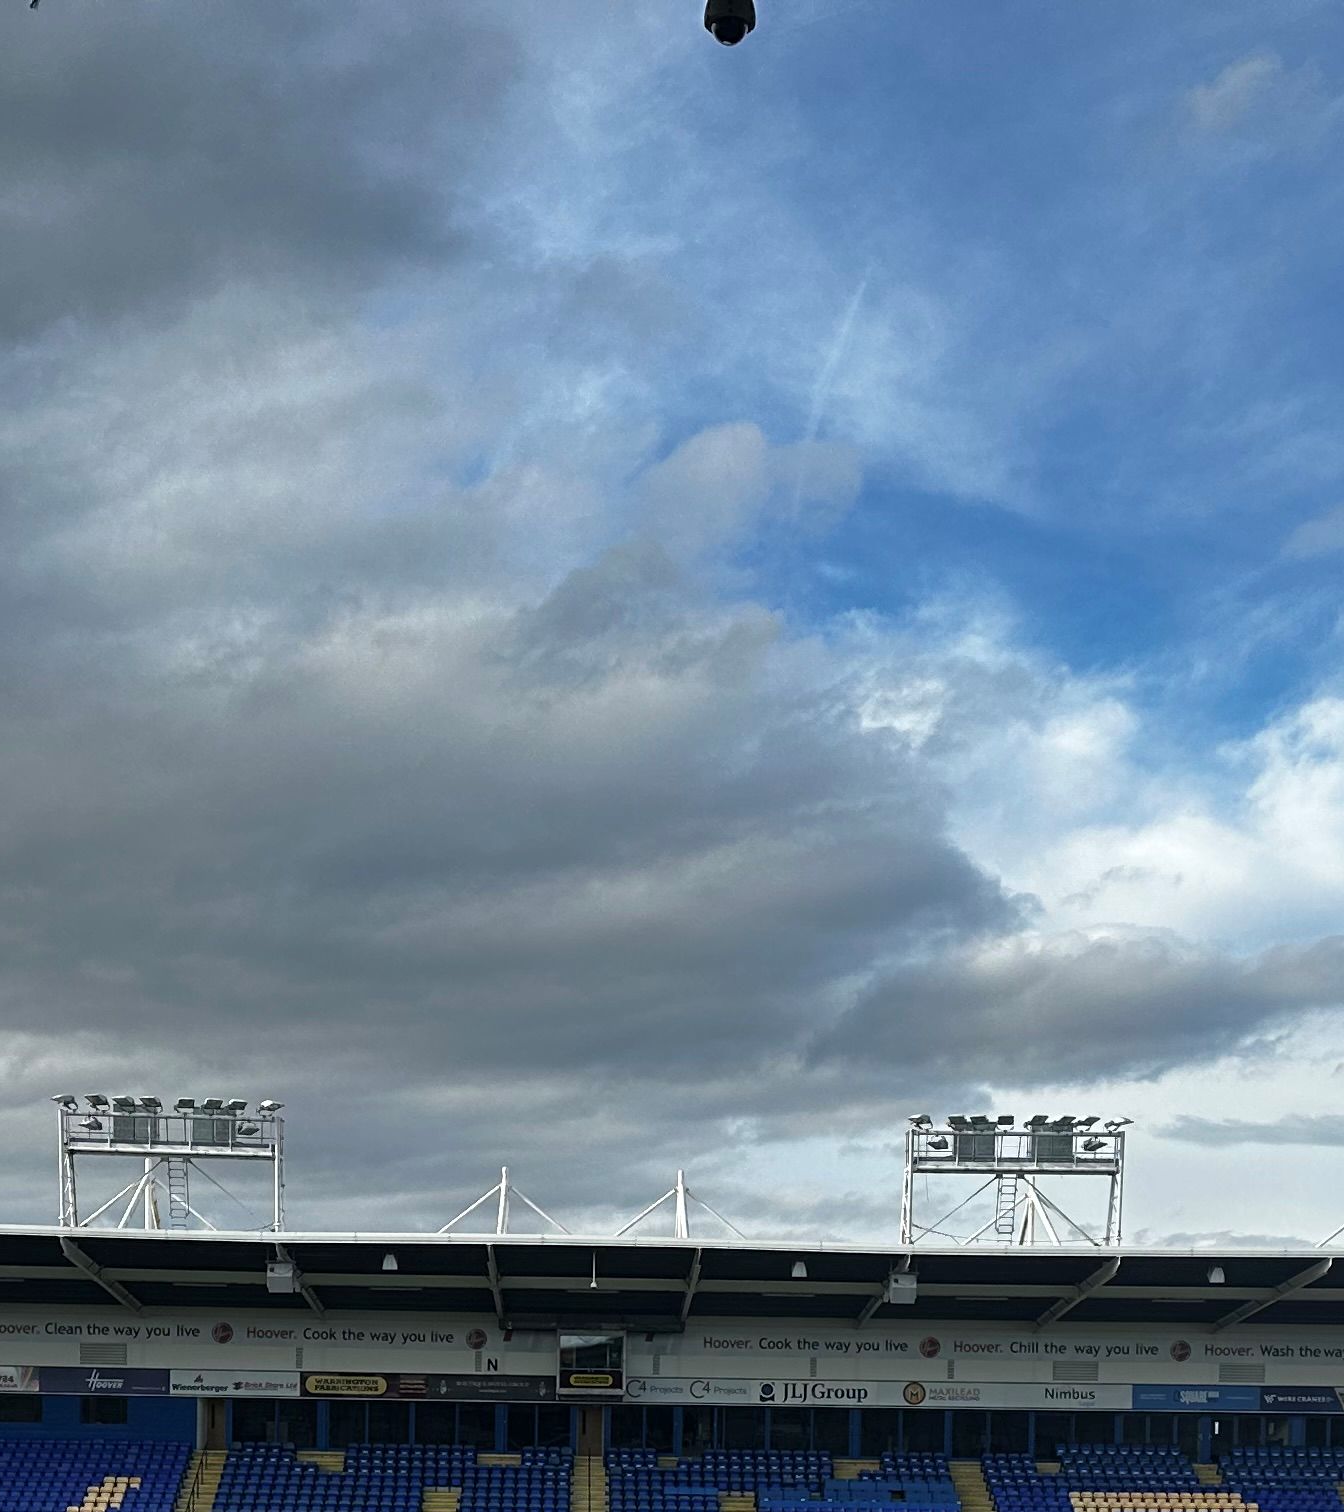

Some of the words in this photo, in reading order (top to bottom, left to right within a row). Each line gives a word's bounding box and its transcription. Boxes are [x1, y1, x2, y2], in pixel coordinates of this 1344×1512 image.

[45, 1322, 82, 1336] Clean
[87, 1323, 110, 1336] the
[114, 1326, 141, 1339] way
[146, 1327, 171, 1339] you
[176, 1325, 200, 1338] live
[303, 1327, 337, 1341] Cook
[342, 1327, 364, 1341] the
[369, 1332, 396, 1344] way
[401, 1332, 426, 1344] you
[431, 1330, 454, 1343] live
[759, 1337, 792, 1351] Cook
[797, 1338, 819, 1351] the
[824, 1341, 850, 1353] way
[855, 1341, 880, 1353] you
[885, 1339, 908, 1352] live
[1010, 1341, 1039, 1354] Chill
[1044, 1342, 1067, 1354] the
[1074, 1345, 1100, 1357] way
[1105, 1345, 1130, 1357] you
[1136, 1343, 1159, 1355] live
[1260, 1344, 1294, 1358] Wash
[1299, 1345, 1321, 1358] the
[487, 1358, 498, 1371] N
[782, 1382, 810, 1403] JLJ
[812, 1382, 868, 1403] Group
[1045, 1387, 1097, 1400] Nimbus
